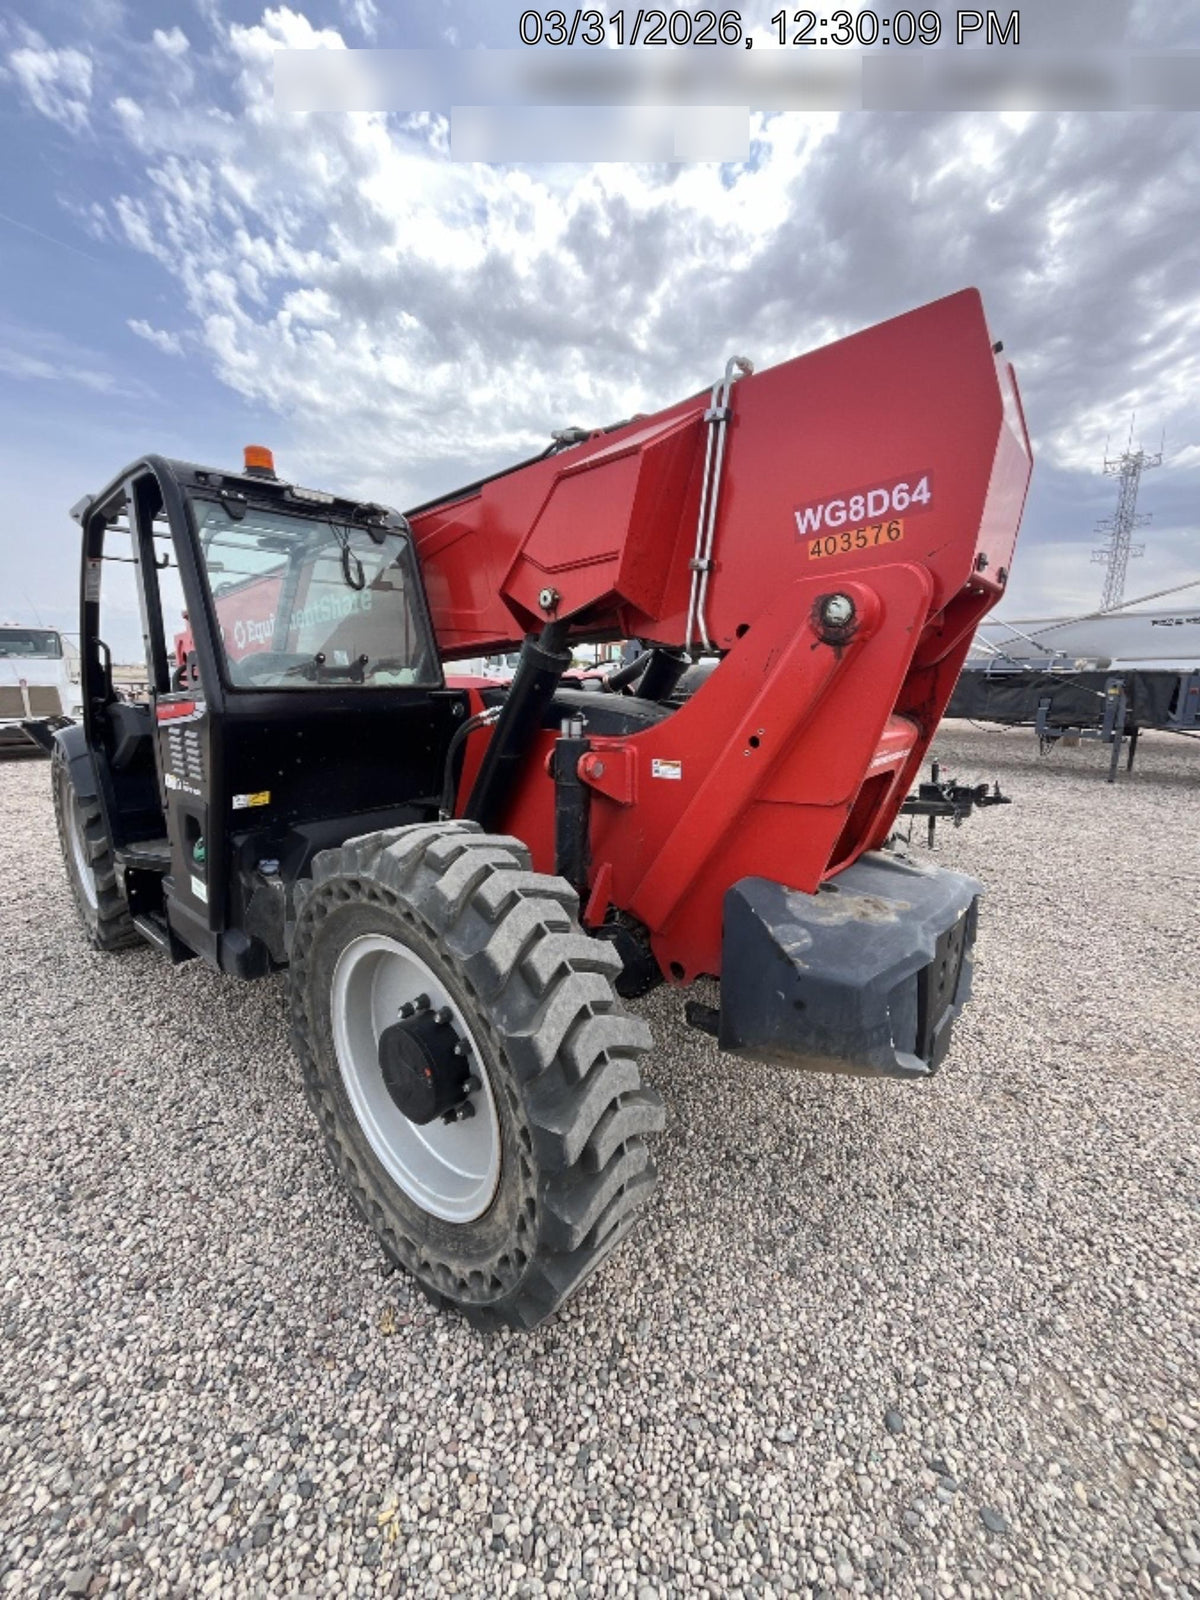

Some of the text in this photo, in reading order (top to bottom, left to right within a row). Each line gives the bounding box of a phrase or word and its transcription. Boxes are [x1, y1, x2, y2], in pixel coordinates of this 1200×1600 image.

[795, 476, 931, 534] WG8D64
[810, 520, 901, 557] 403576
[247, 589, 373, 644] EquientShare
